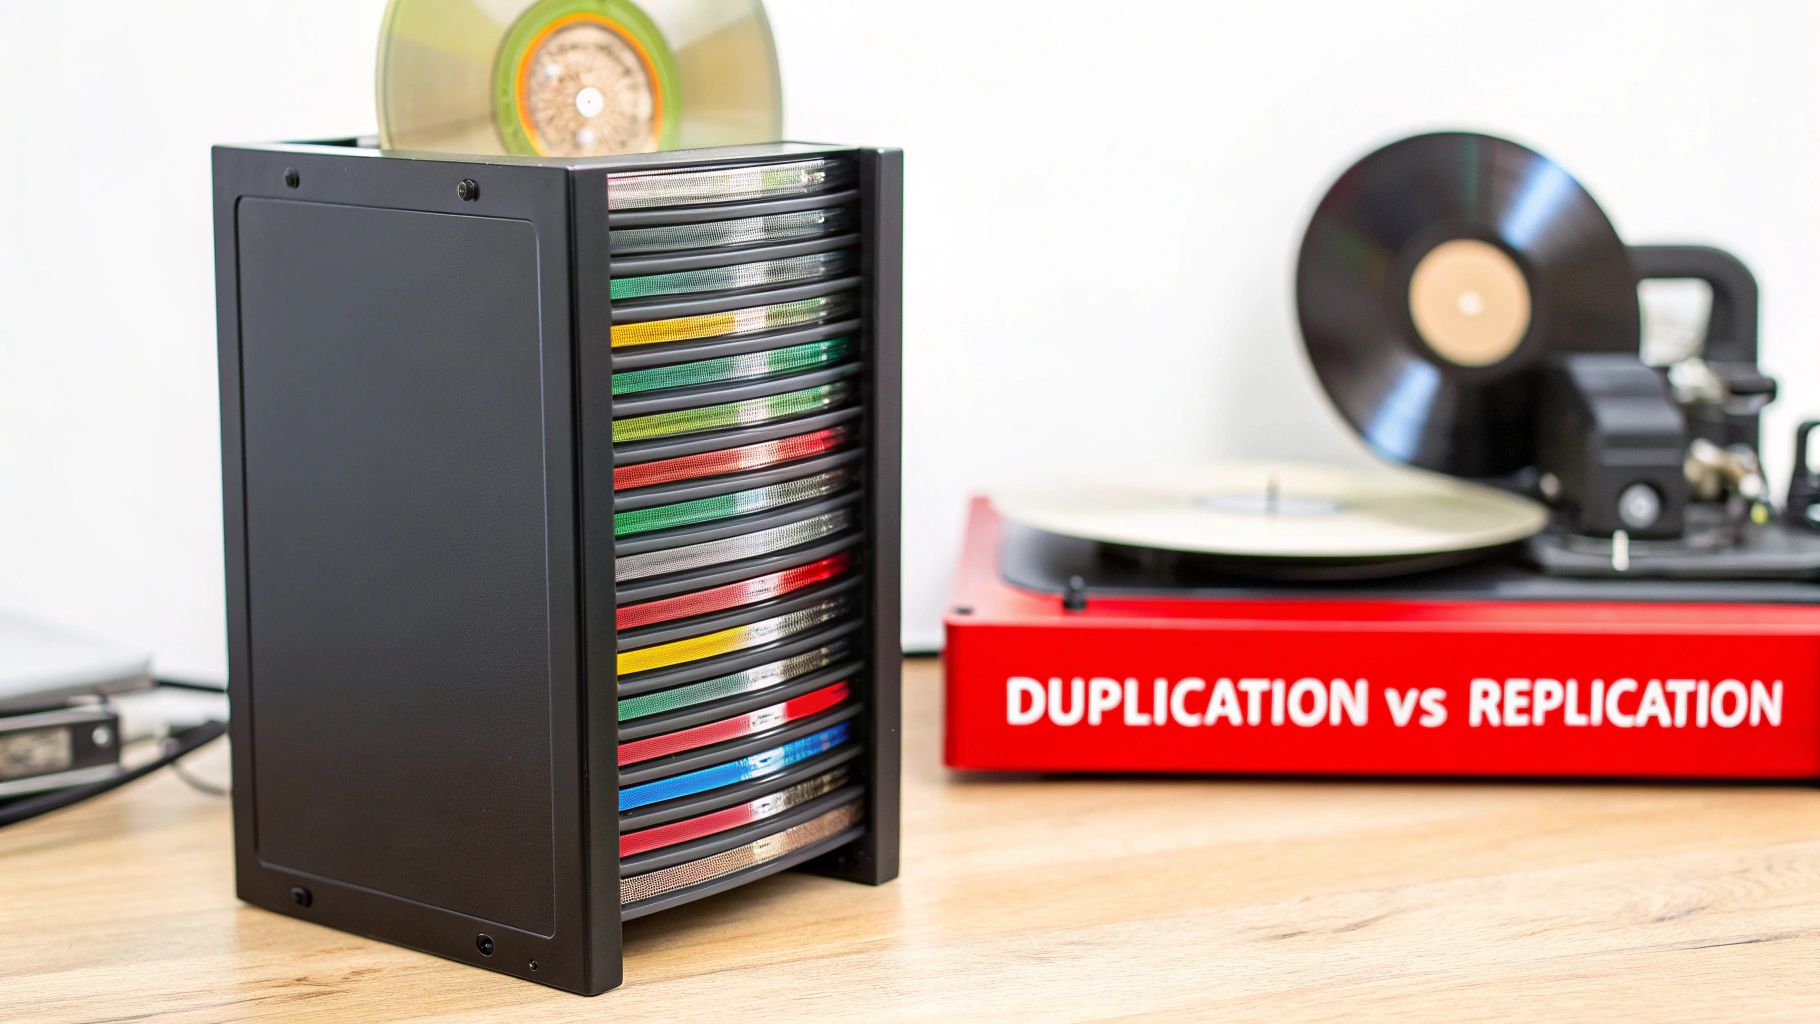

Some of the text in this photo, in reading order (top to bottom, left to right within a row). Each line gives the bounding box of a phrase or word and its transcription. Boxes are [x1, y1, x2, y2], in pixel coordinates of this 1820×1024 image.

[1006, 677, 1783, 728] DUPLICATION vs REPLICATION
